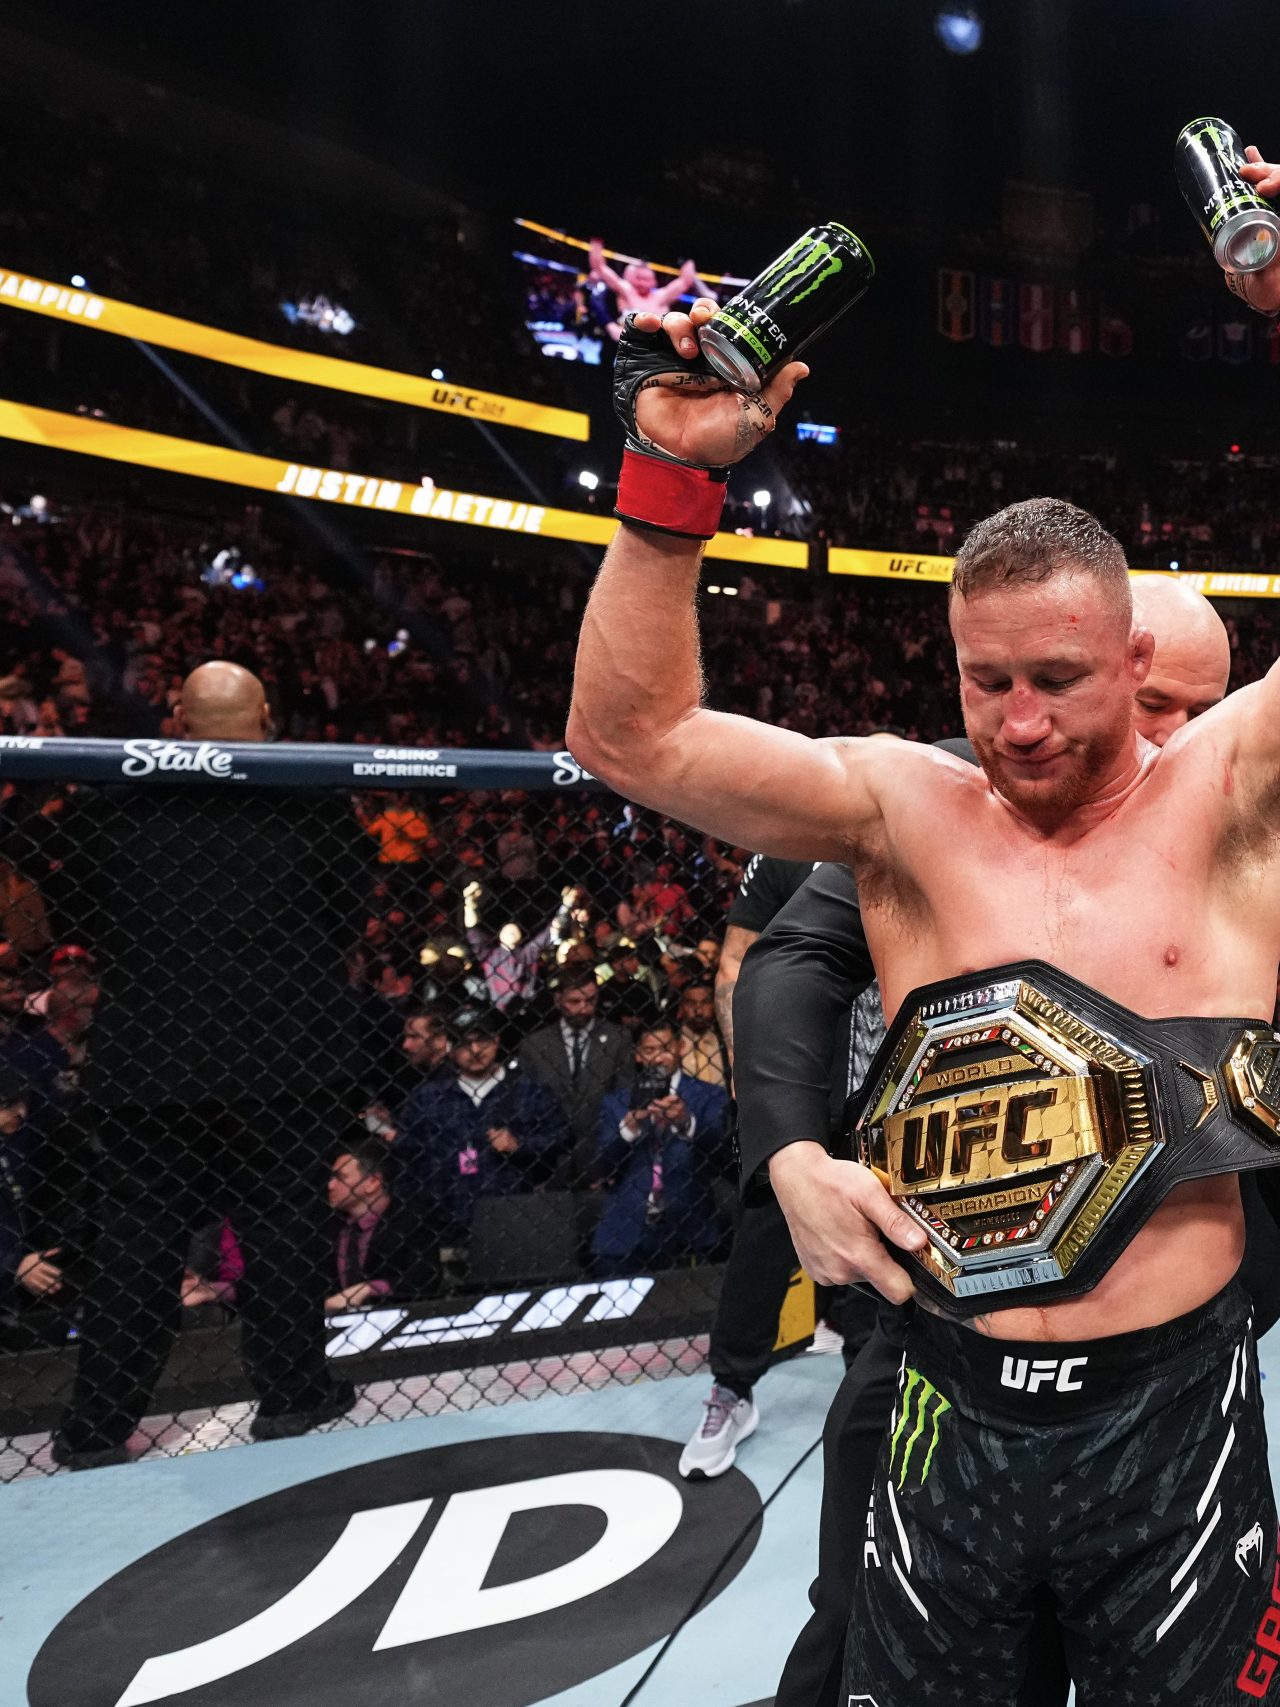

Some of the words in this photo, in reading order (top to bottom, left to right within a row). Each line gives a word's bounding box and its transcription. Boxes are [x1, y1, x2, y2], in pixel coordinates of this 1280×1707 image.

[0, 272, 105, 320] AMPION
[432, 388, 478, 412] UFC
[276, 464, 402, 510] JUSTIN
[410, 486, 545, 534] GAETHJE
[889, 559, 927, 575] UFC
[121, 738, 234, 778] Stake
[353, 762, 458, 778] EXPERIENCE
[372, 748, 440, 761] CASINO
[935, 1058, 1013, 1087] WORLD
[901, 1087, 1059, 1184] UFC
[939, 1186, 1042, 1218] CHAMPION
[1000, 1355, 1089, 1394] UFC
[114, 1468, 684, 1707] JD
